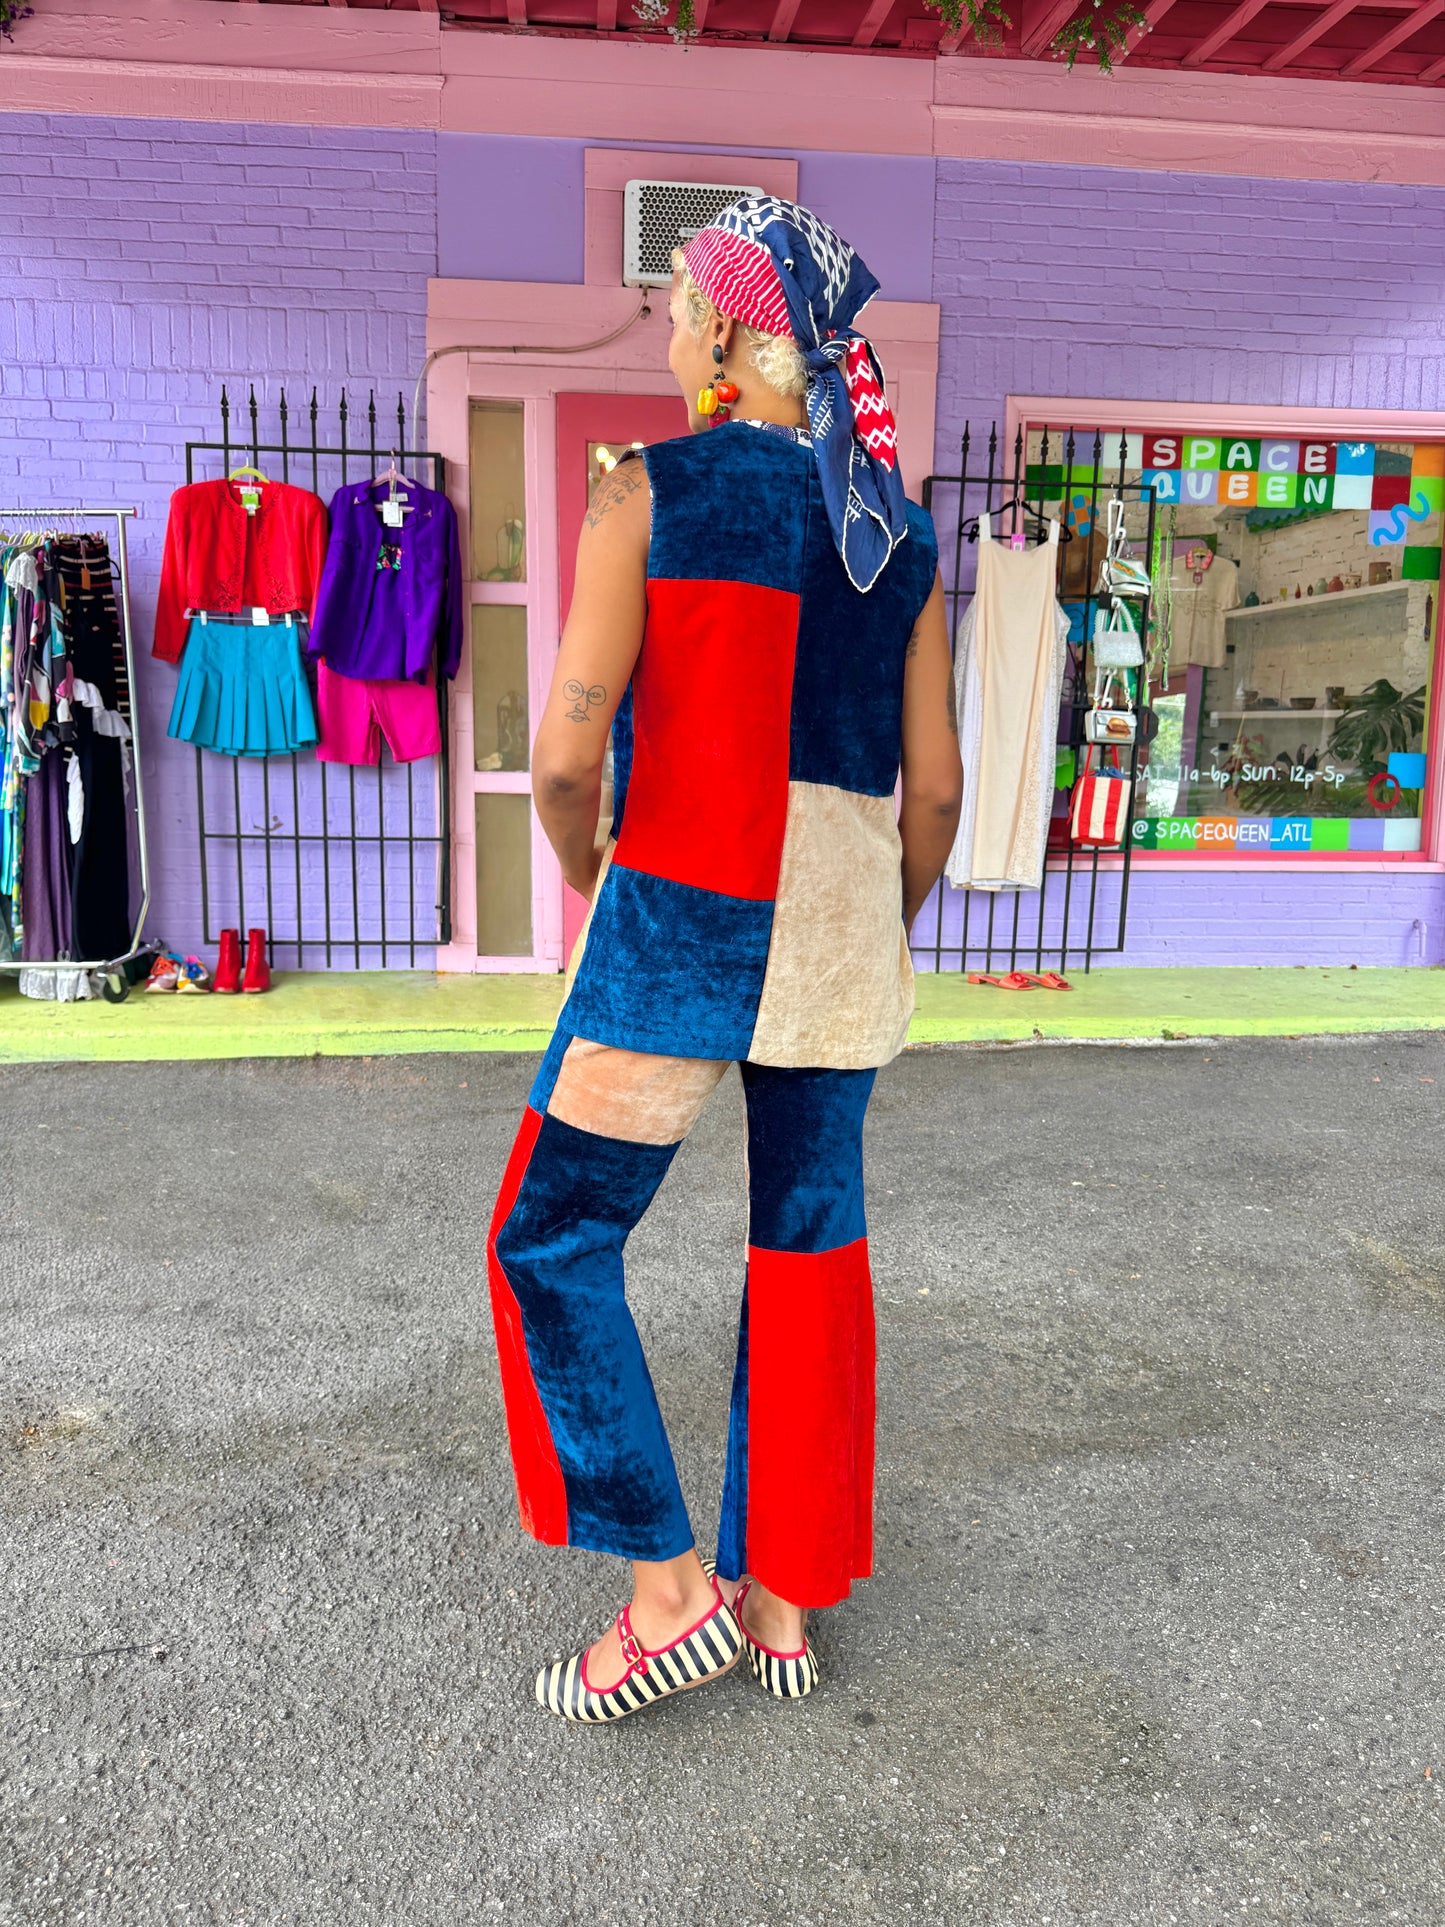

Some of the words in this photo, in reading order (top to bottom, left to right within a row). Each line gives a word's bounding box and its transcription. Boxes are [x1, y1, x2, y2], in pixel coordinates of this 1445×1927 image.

[1152, 439, 1328, 473] SPACE
[1150, 472, 1328, 505] QUEEN
[1241, 764, 1282, 781] Sun:
[1290, 765, 1345, 790] 12p-5p
